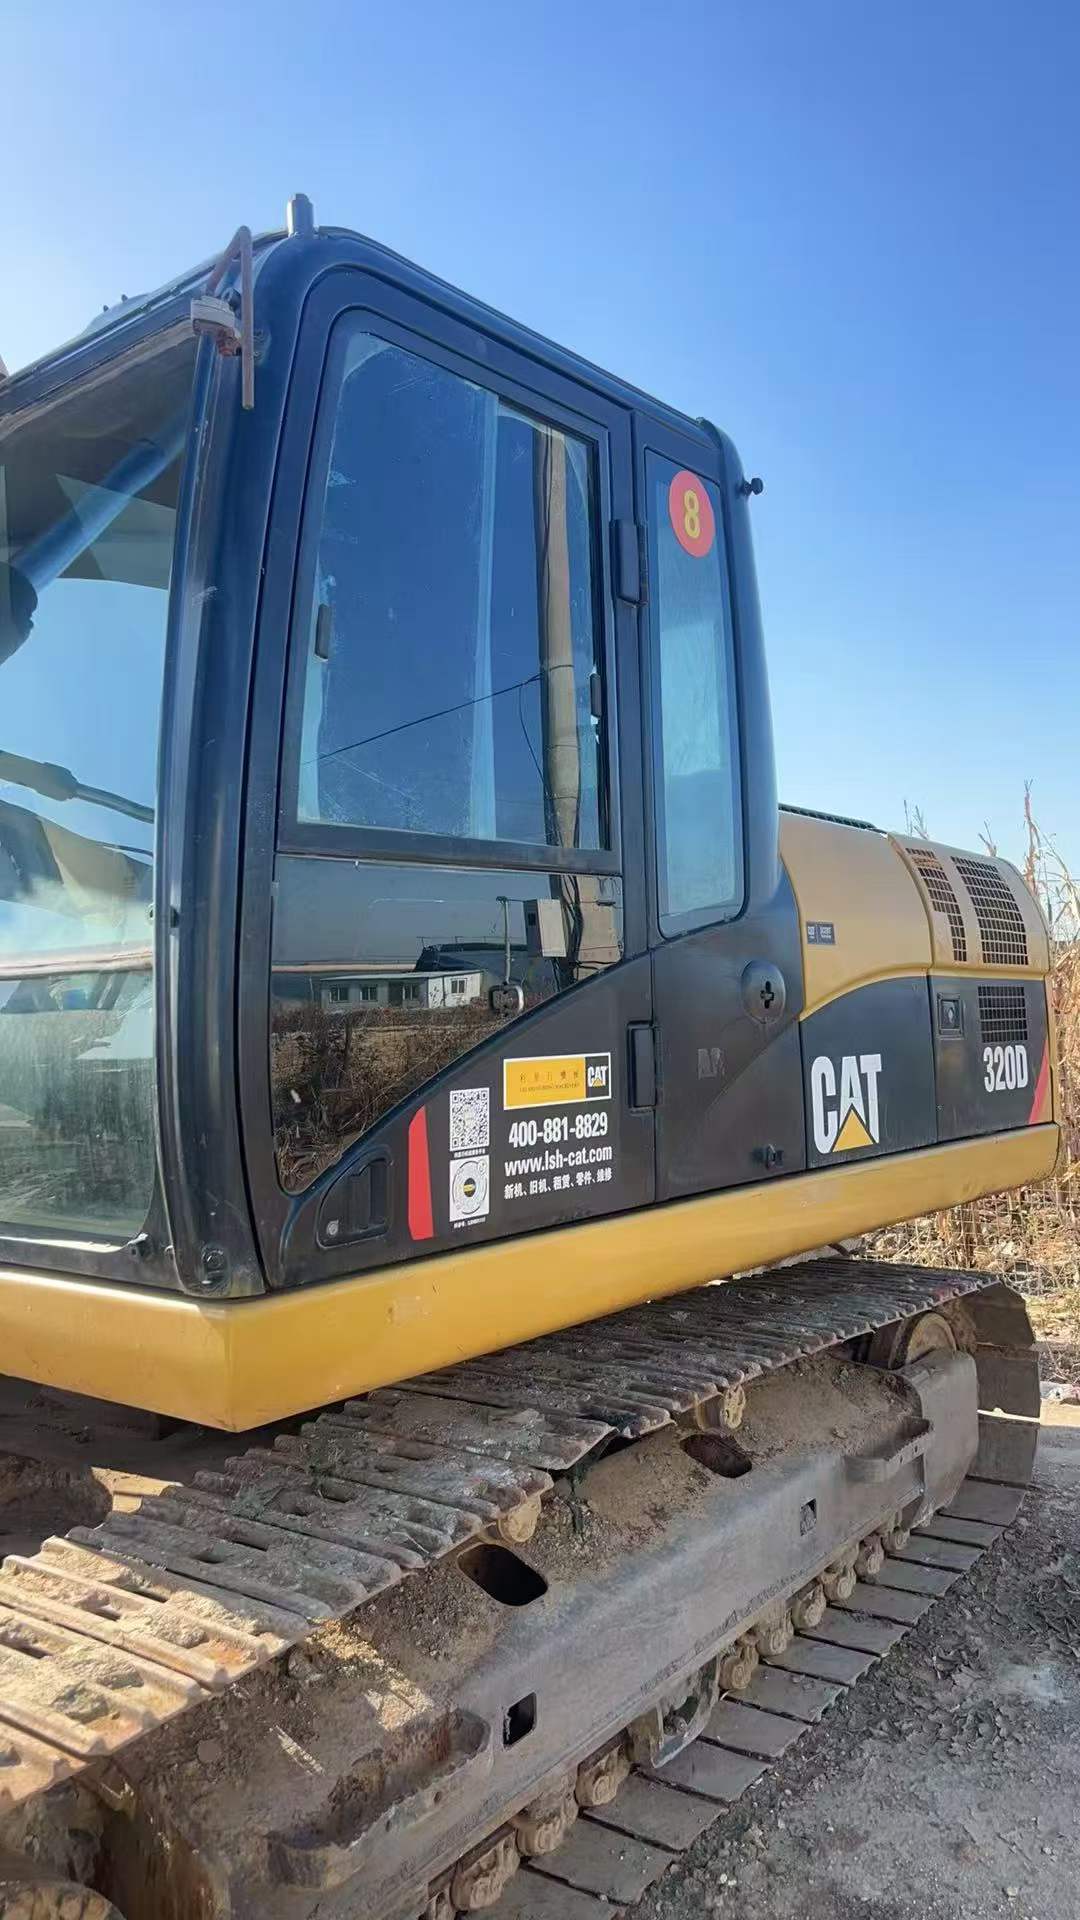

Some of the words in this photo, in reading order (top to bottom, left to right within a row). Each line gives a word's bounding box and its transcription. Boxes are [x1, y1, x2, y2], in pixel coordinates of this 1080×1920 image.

[683, 489, 700, 539] 8
[587, 1065, 608, 1087] CAT
[983, 1045, 1029, 1092] 320D
[811, 1053, 882, 1154] CAT
[508, 1111, 608, 1148] 400-881-8829
[504, 1145, 613, 1177] www.lsh-cat.com
